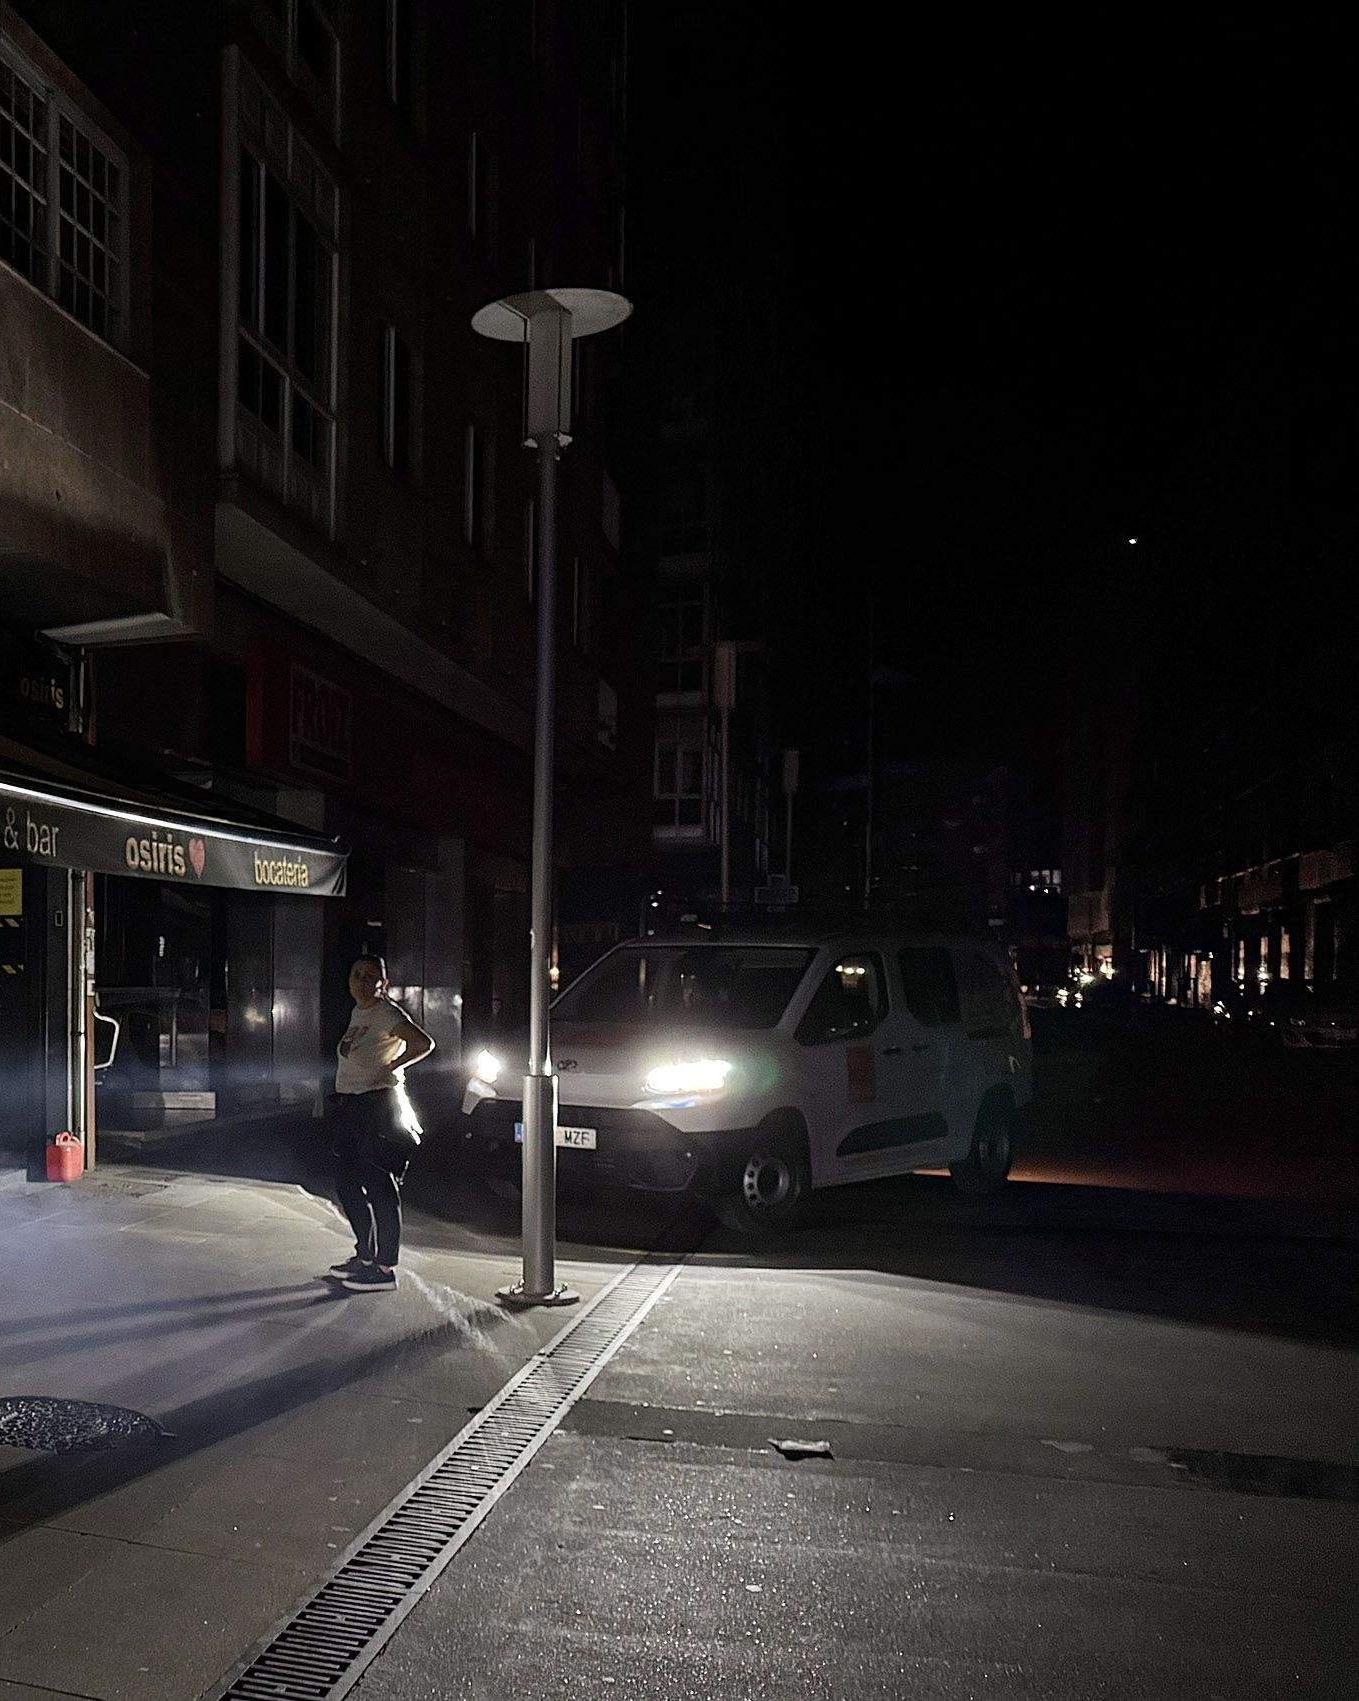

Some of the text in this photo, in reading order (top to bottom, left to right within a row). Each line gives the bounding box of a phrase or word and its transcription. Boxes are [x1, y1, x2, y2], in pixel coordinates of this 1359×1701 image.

[20, 677, 64, 709] osiris
[4, 806, 19, 850] &
[27, 811, 59, 857] bar
[125, 830, 186, 877] osiris
